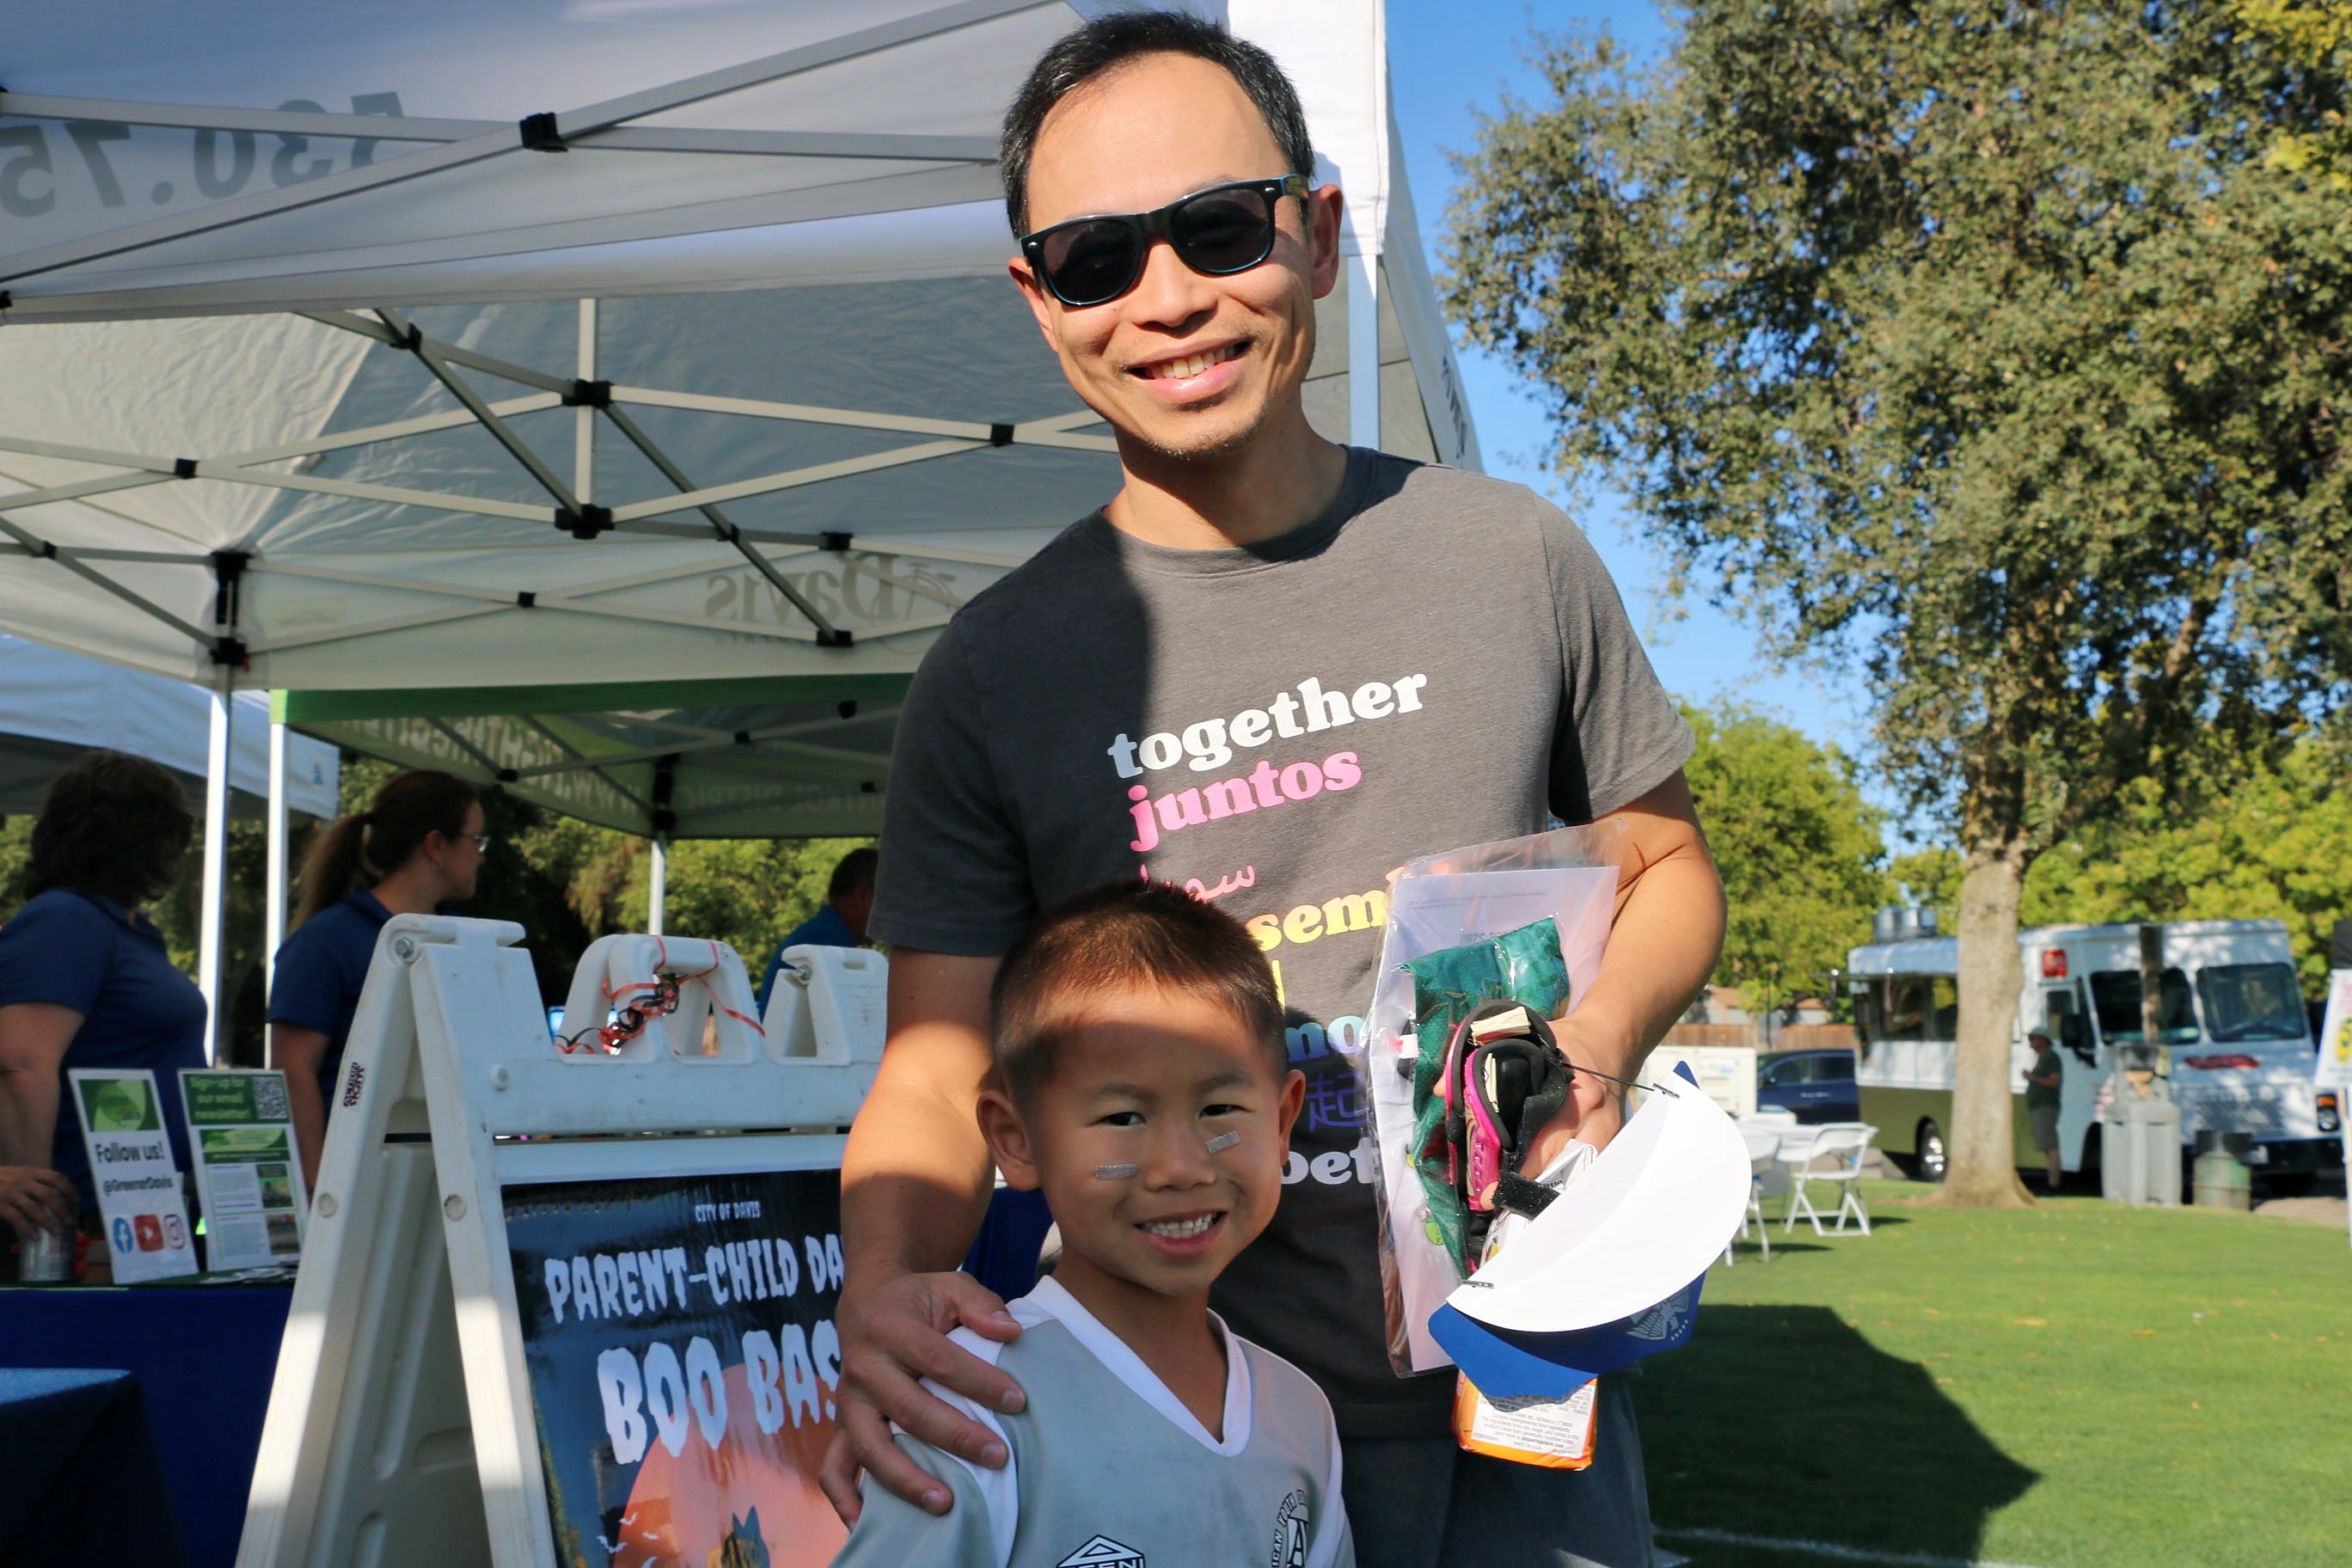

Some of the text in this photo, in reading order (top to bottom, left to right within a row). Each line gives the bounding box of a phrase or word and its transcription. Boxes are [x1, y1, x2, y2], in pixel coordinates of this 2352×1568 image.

[1107, 674, 1428, 779] together
[1128, 750, 1363, 852] juntos
[1246, 882, 1391, 952] sem
[1305, 1072, 1369, 1132] 起
[95, 1140, 164, 1163] Follow us!
[103, 1175, 174, 1196] @GreenerDavis
[695, 1201, 762, 1222] CITY OF DAVIS
[544, 1234, 844, 1324] PARENT-CHILD DA
[597, 1319, 842, 1465] BOO BAS
[1271, 1529, 1283, 1568] ICAN
